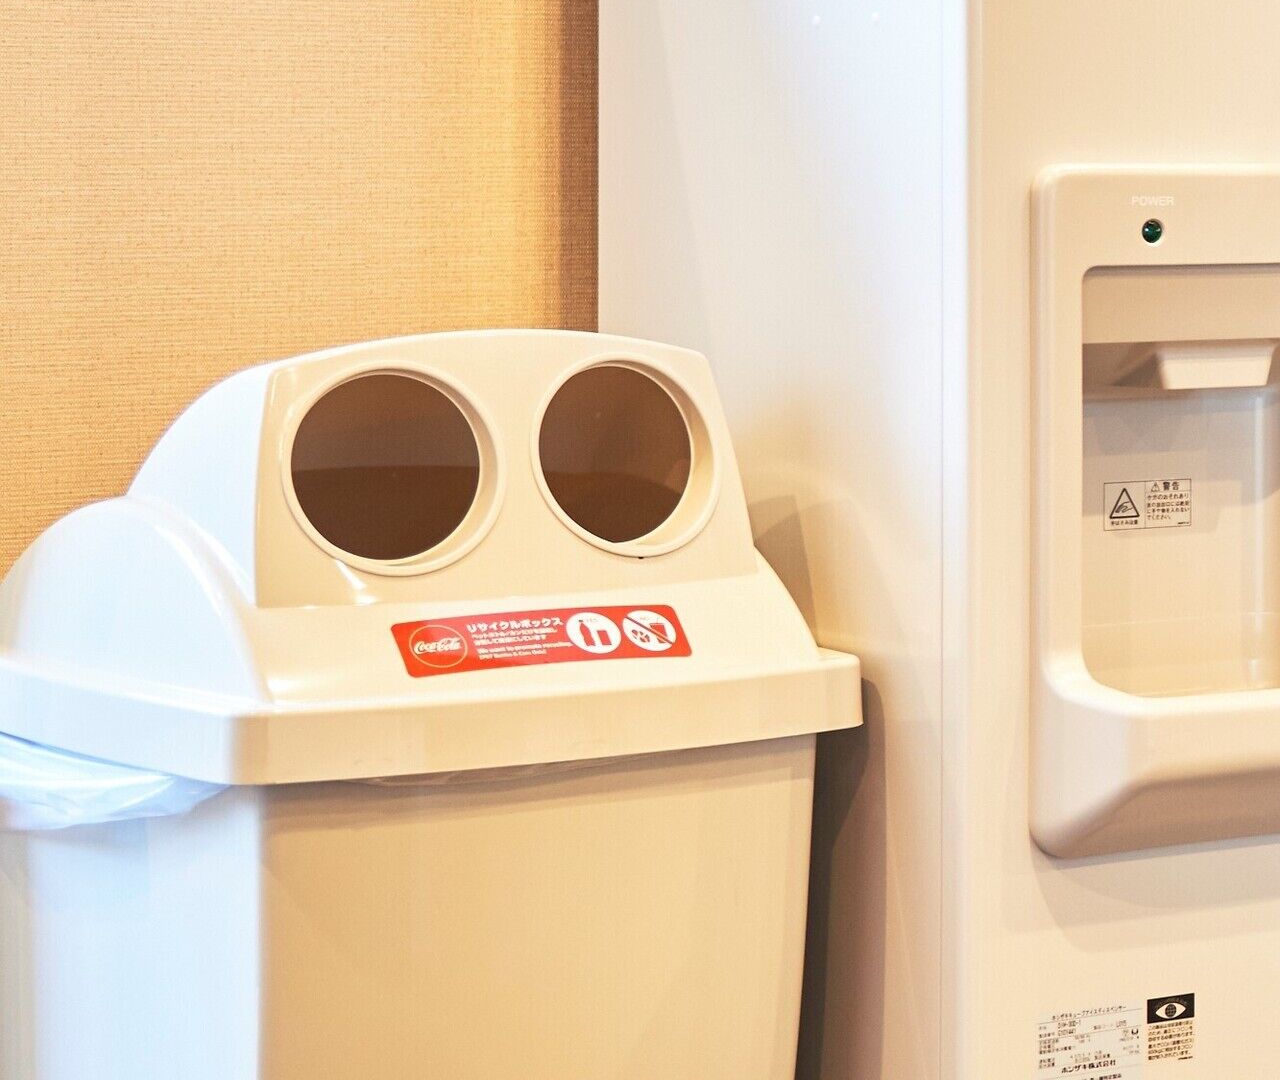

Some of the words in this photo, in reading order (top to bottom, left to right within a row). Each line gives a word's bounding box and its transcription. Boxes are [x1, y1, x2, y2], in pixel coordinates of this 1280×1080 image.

[1131, 195, 1175, 207] POWER
[1162, 481, 1180, 491] 警告
[466, 617, 564, 633] リサイクルボックス
